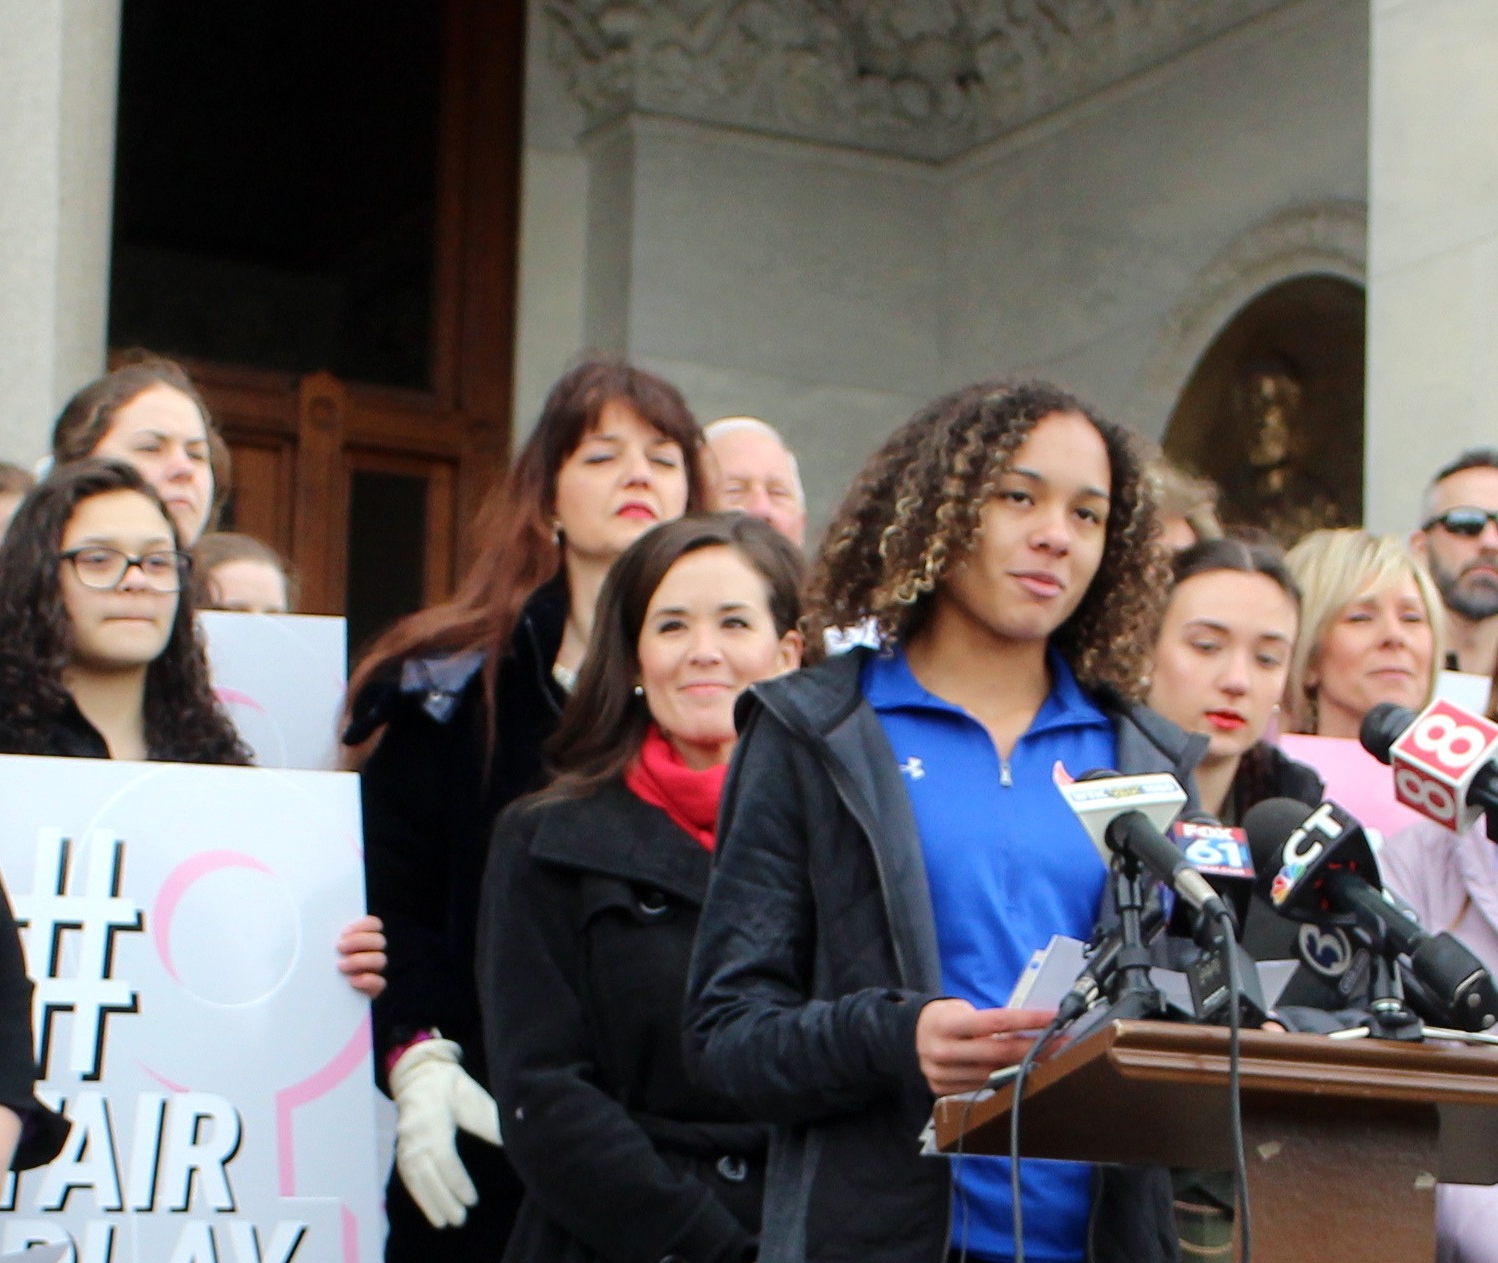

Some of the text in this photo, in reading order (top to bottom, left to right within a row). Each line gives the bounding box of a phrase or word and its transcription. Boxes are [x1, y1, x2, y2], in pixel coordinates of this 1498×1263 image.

[1414, 714, 1485, 767] 8
[1397, 768, 1454, 820] 8
[1183, 822, 1235, 841] FOX
[1186, 837, 1243, 868] 61
[1283, 803, 1343, 866] CT
